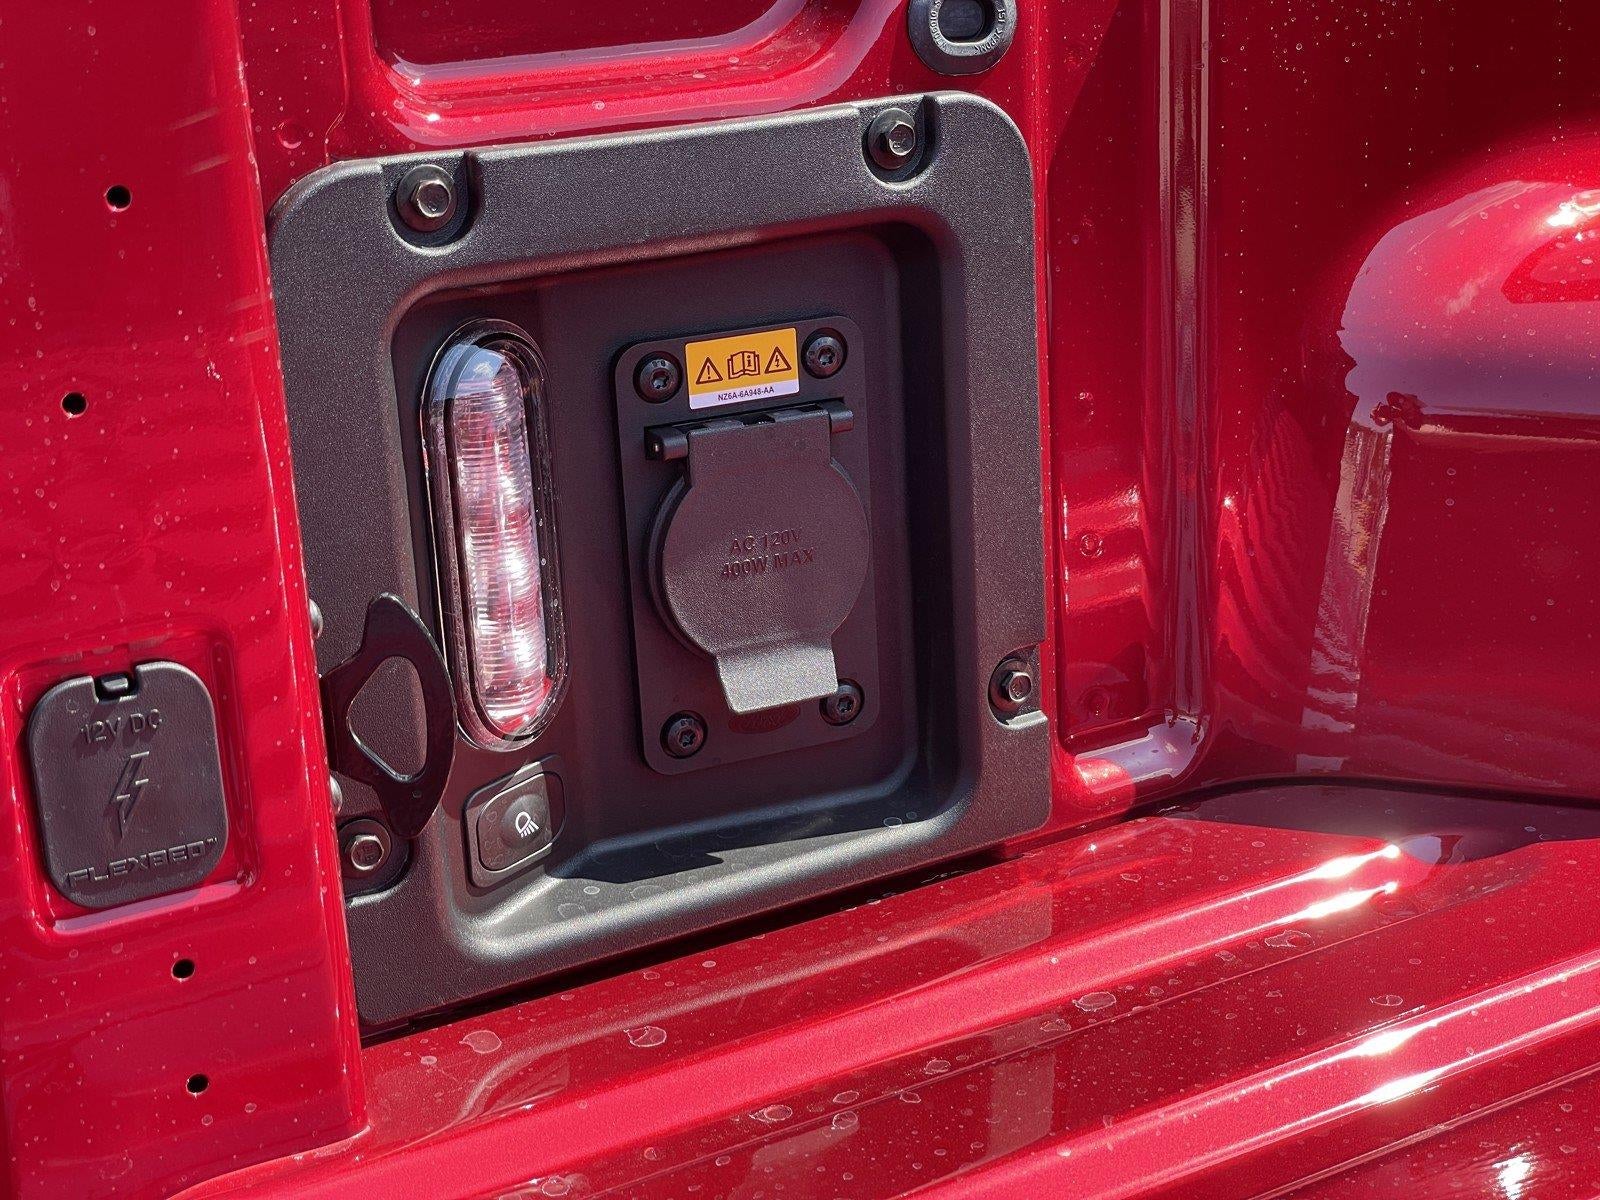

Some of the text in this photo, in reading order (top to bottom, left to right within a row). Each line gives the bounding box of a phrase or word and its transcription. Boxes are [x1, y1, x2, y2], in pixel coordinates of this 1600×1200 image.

[717, 386, 775, 402] NZ6A-6A948-AA
[730, 528, 801, 554] AC 120V
[721, 547, 815, 577] 400W MAX
[80, 708, 163, 744] 12V DC
